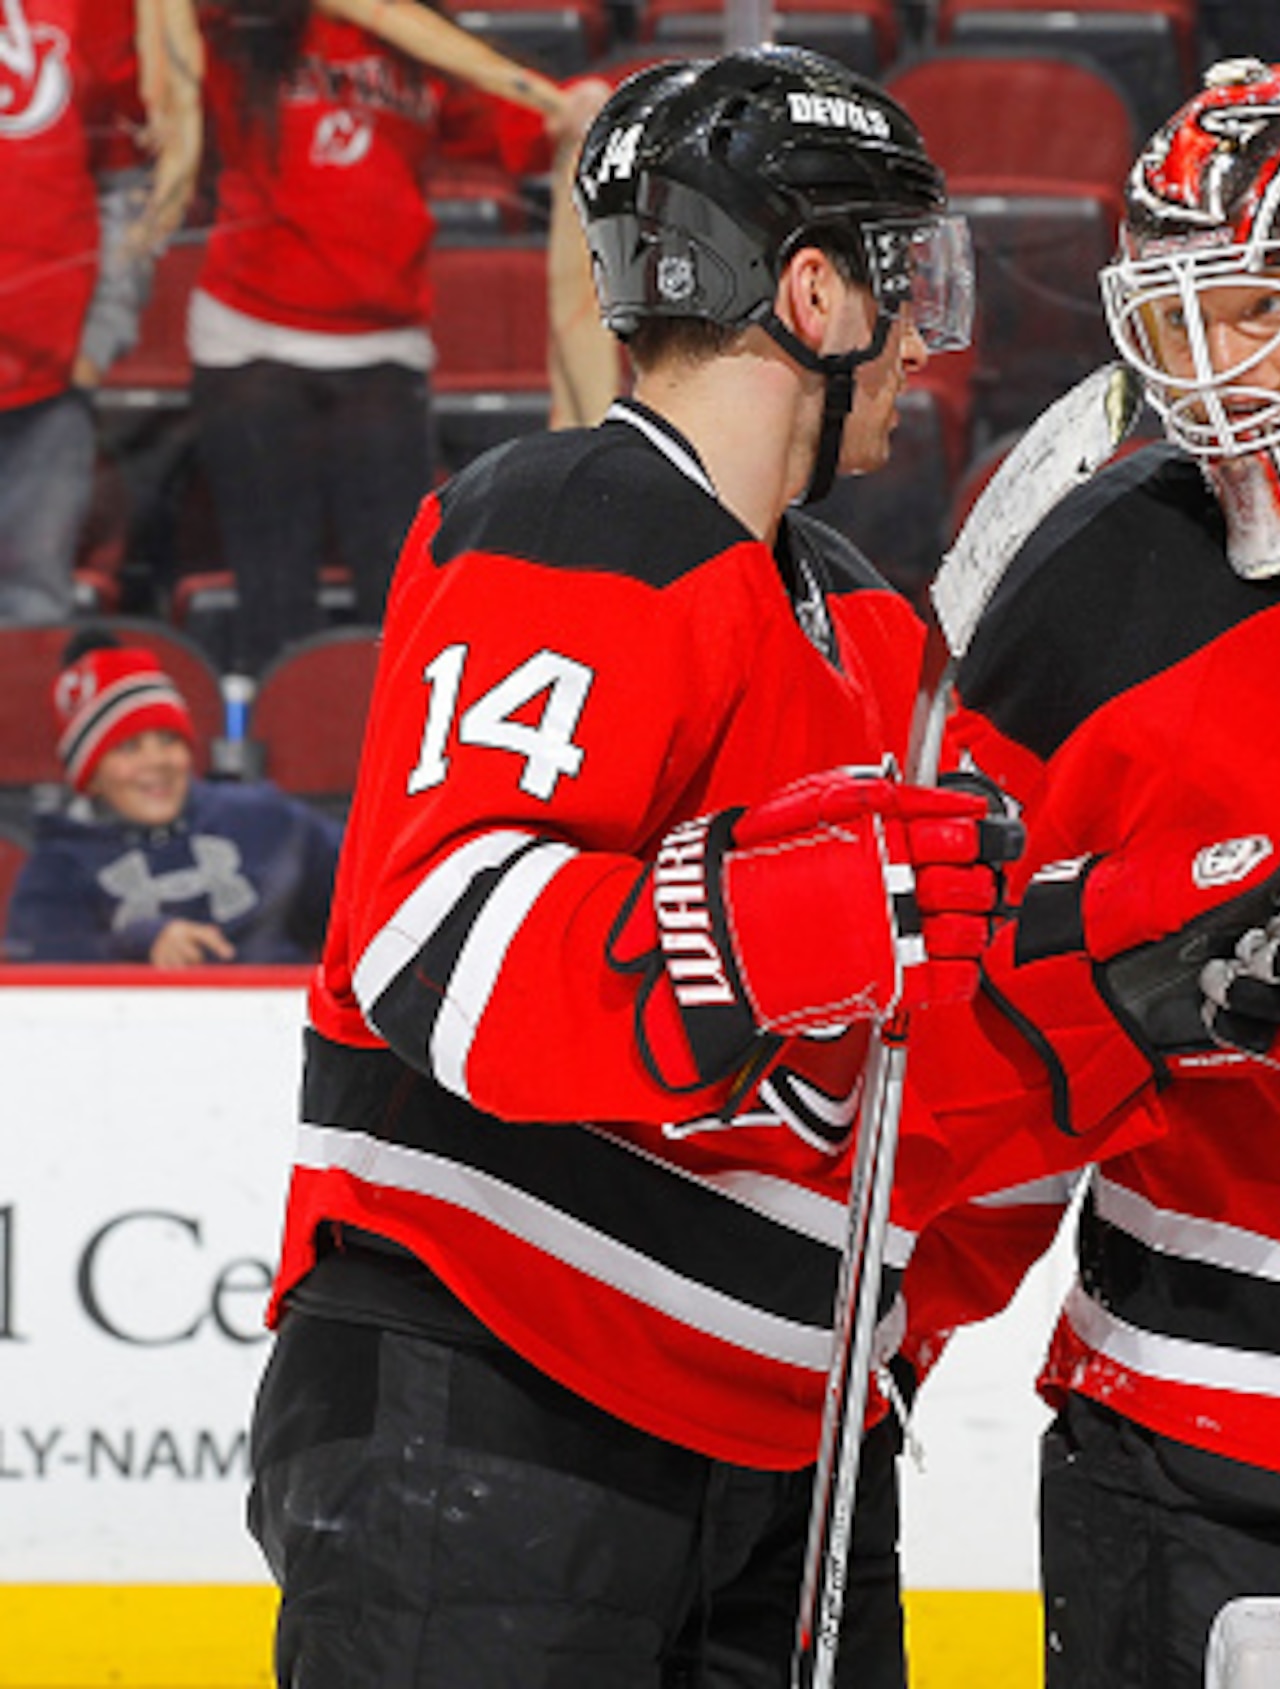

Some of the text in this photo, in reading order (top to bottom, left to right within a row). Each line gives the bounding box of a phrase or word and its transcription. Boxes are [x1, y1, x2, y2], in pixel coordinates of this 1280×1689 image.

[786, 91, 890, 140] DEVILS
[598, 122, 645, 185] 14
[407, 643, 596, 802] 14
